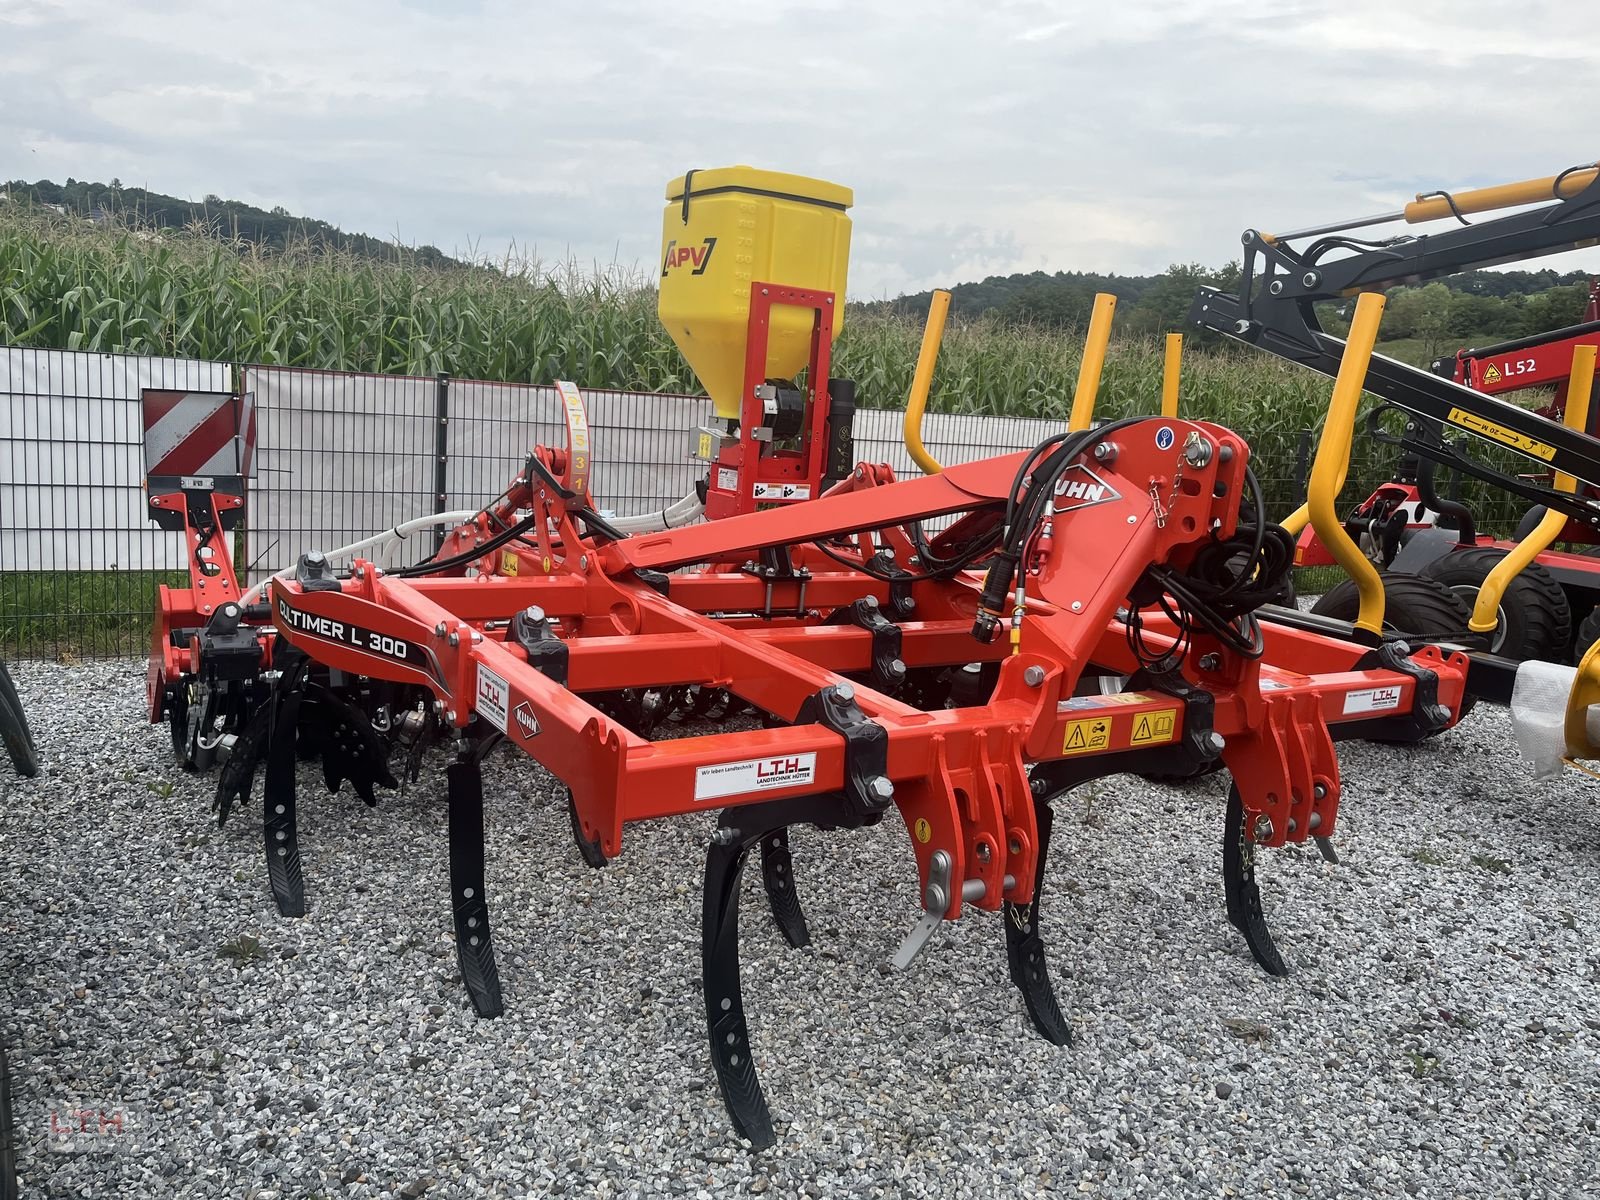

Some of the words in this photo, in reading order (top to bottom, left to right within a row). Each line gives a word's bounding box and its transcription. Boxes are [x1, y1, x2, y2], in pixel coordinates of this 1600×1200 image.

[1505, 362, 1515, 376] L
[1516, 359, 1536, 374] 52
[572, 414, 582, 425] 7
[576, 434, 585, 447] 5
[575, 456, 585, 469] 3
[575, 478, 583, 490] 1
[1054, 479, 1105, 502] UHN
[280, 600, 344, 640] CULTIMER
[351, 627, 363, 646] L
[369, 633, 407, 658] 300
[516, 708, 537, 733] KUHN
[757, 775, 791, 784] LANDTECHNIK
